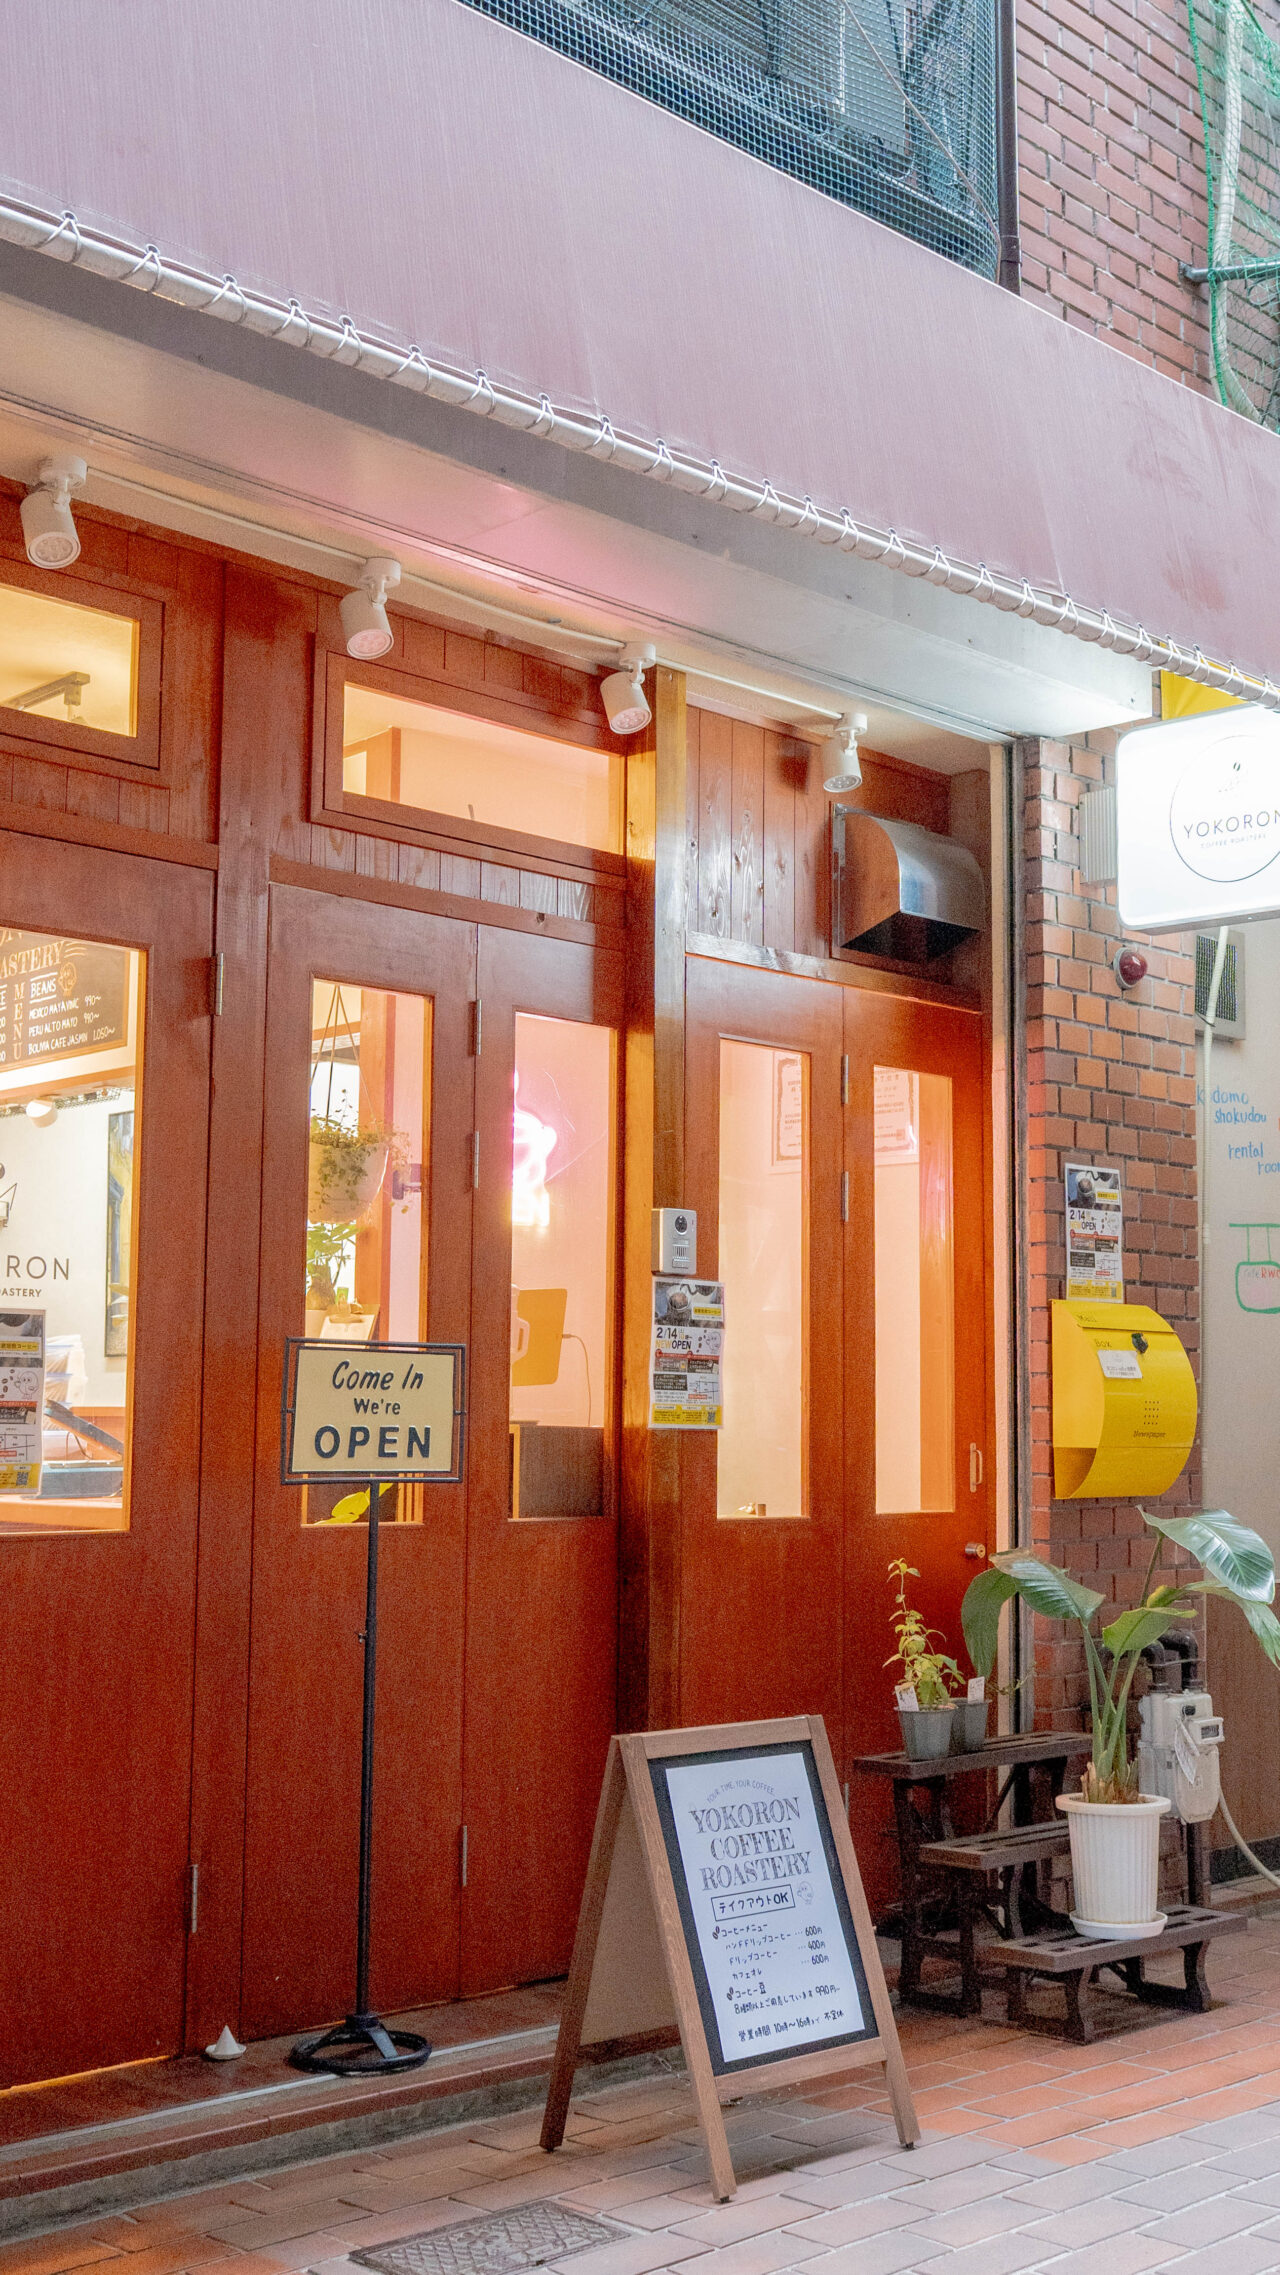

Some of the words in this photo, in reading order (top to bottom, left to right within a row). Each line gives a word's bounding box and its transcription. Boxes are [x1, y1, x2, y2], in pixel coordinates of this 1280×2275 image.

[30, 978, 57, 999] BEANS
[28, 1024, 44, 1038] PERU
[50, 1036, 67, 1050] CAFE
[1214, 1105, 1268, 1125] shokudou
[1228, 1141, 1264, 1160] rental
[671, 1340, 692, 1350] OPEN
[332, 1360, 395, 1390] Come
[401, 1362, 424, 1390] In
[353, 1397, 401, 1415] We're
[314, 1425, 432, 1459] OPEN
[689, 1796, 801, 1835] YOKORON
[710, 1827, 795, 1861] COFFEE
[699, 1851, 813, 1892] ROASTERY
[719, 1892, 789, 1914] テイクアウトOK
[721, 1923, 768, 1938] コーヒーメニュー
[735, 1982, 767, 1999] コーヒー豆
[738, 2023, 772, 2042] 営業時間
